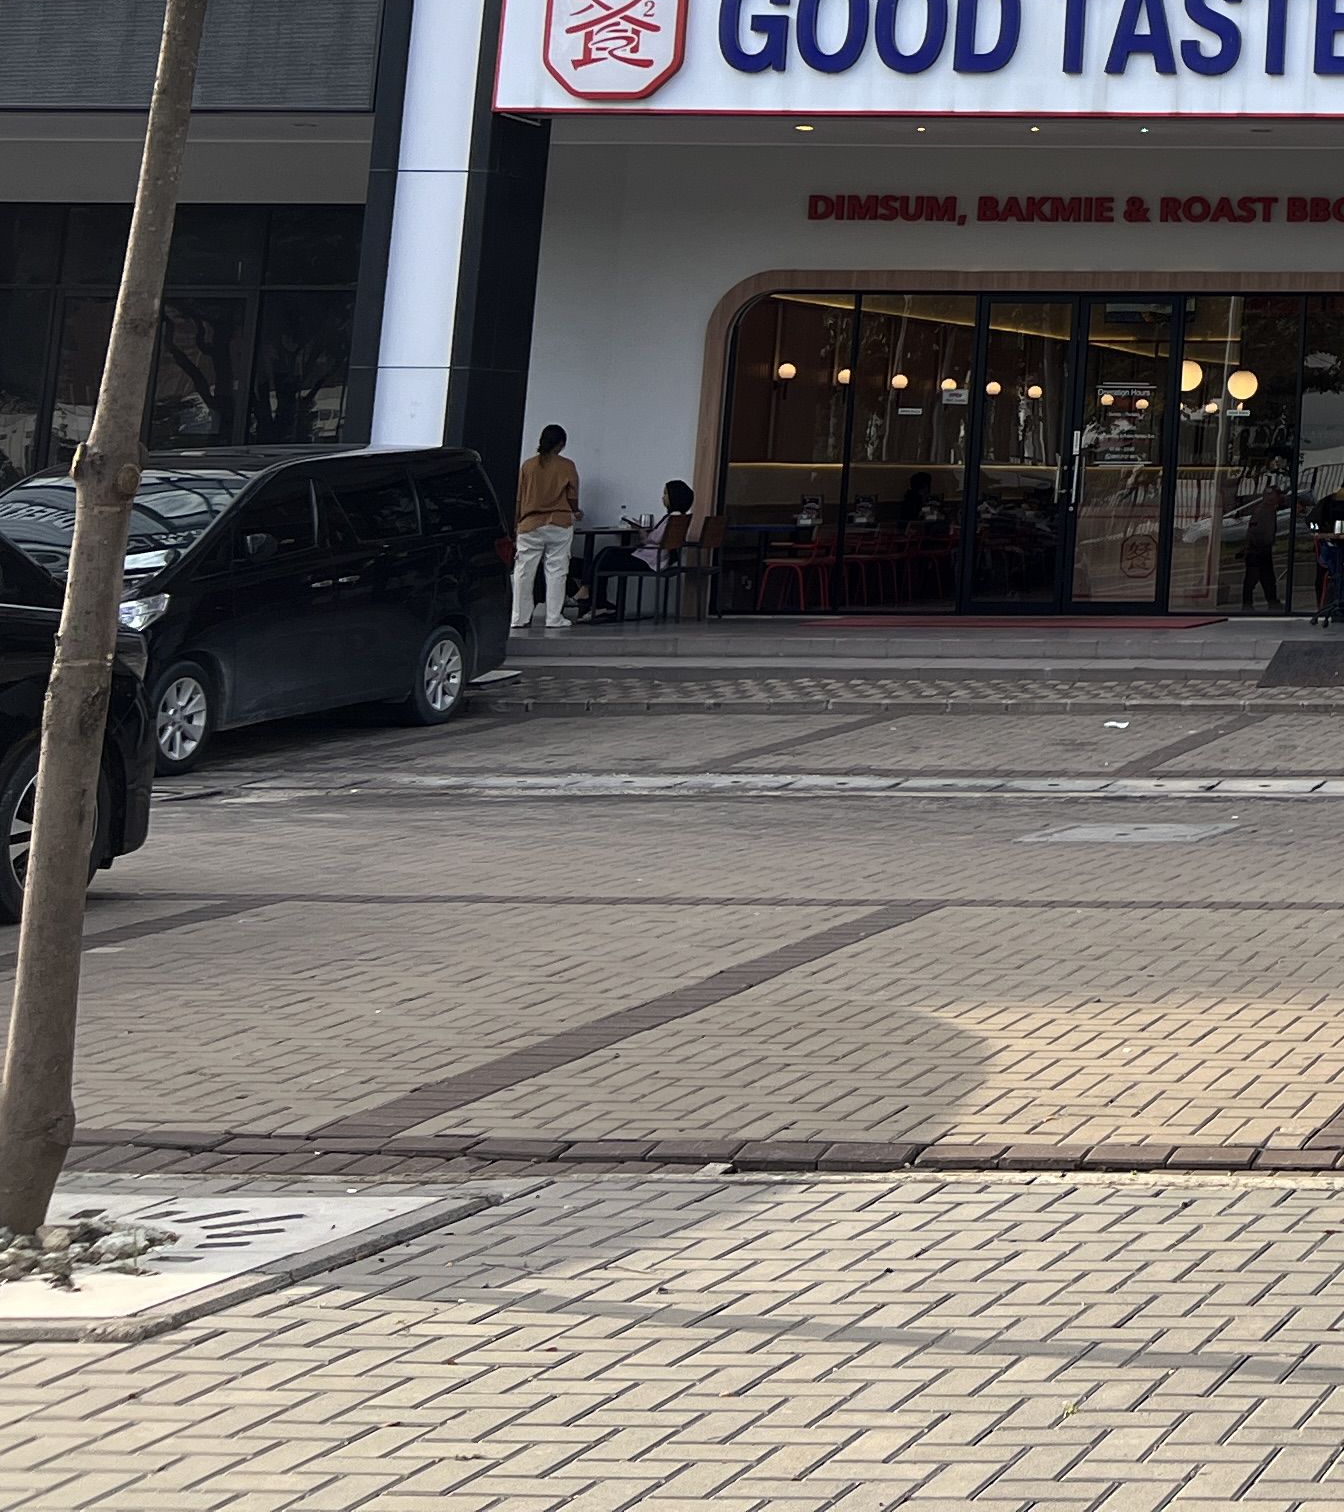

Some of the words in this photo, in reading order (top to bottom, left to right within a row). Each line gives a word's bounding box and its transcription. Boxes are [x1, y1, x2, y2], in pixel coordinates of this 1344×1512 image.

[807, 195, 967, 226] DIMSUM,
[976, 196, 1113, 223] BAKMIE
[1123, 196, 1151, 223] &
[1160, 196, 1279, 223] ROAST
